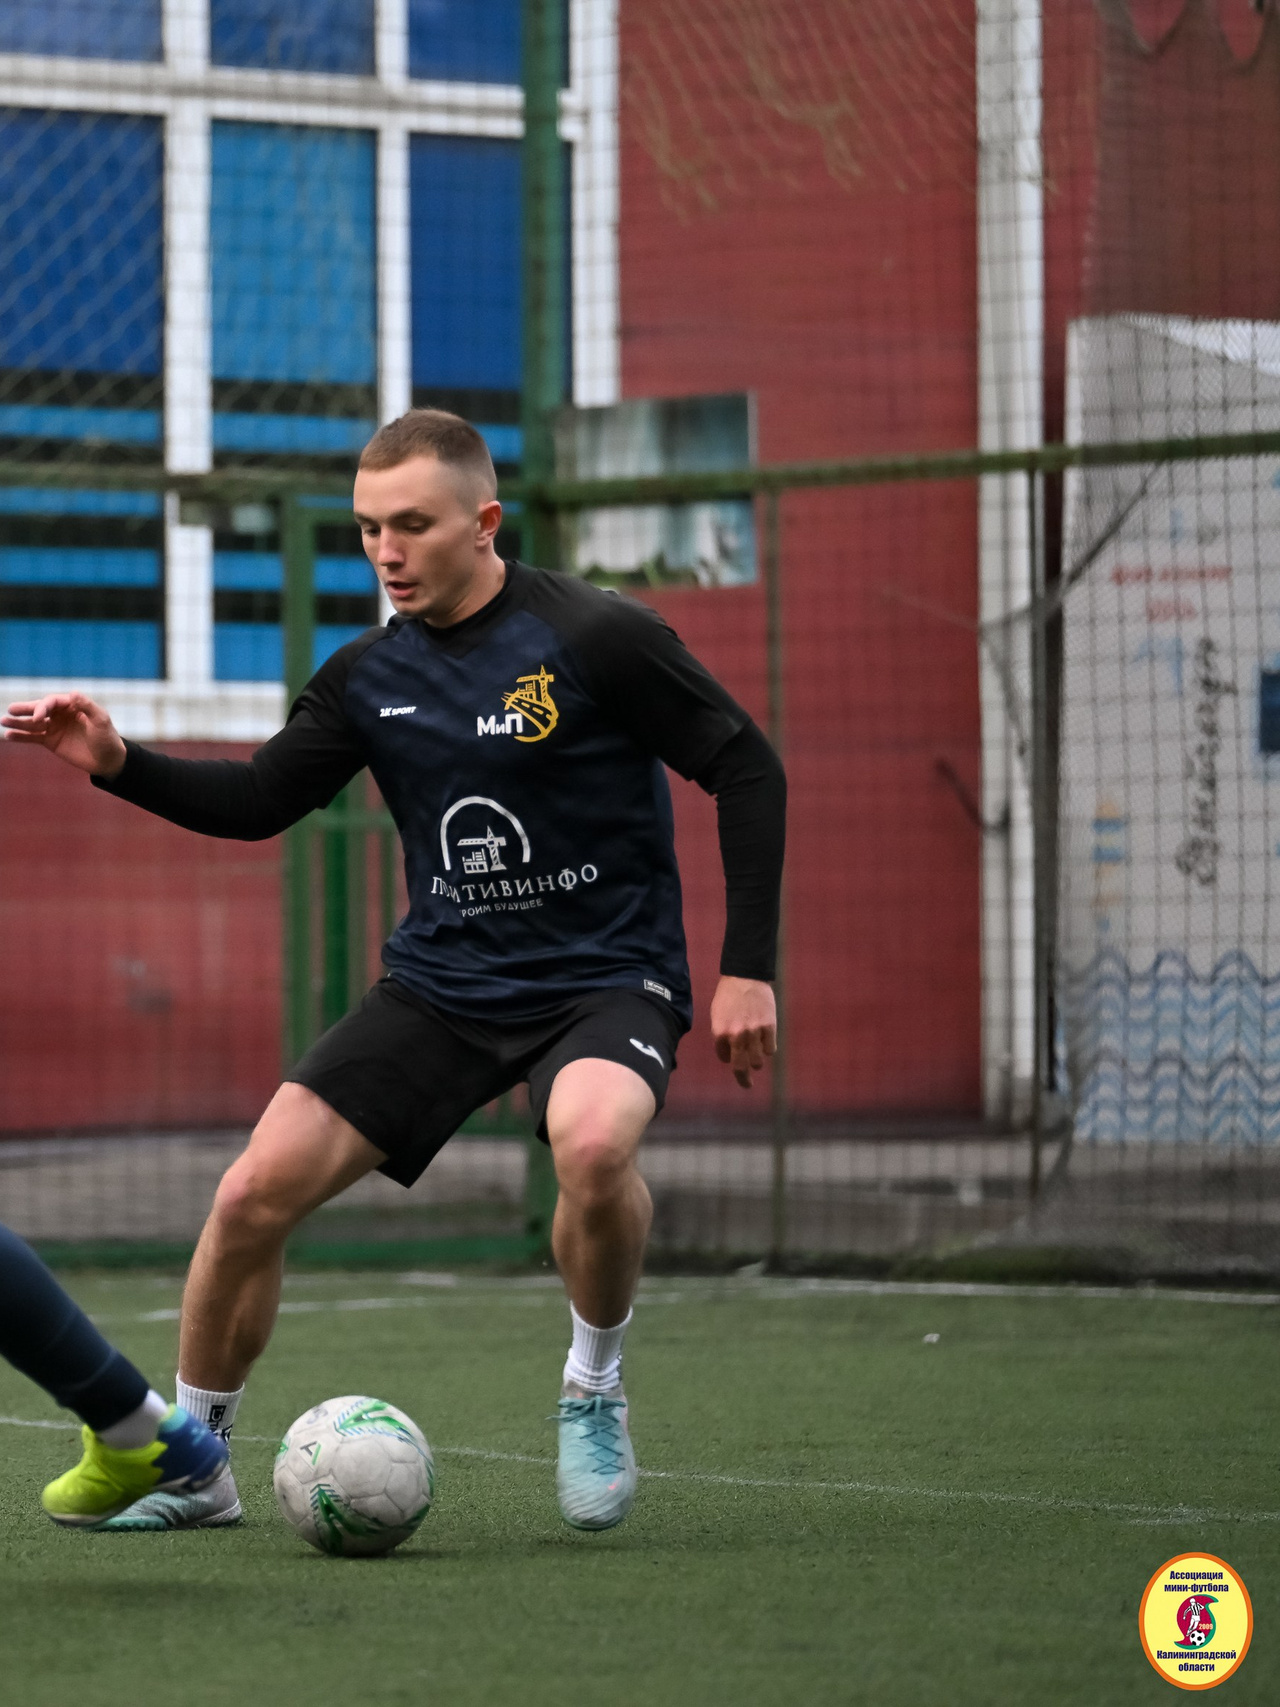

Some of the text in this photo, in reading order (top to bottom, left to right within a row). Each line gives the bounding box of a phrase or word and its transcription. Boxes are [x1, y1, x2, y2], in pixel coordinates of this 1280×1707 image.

[392, 705, 417, 716] SPORT
[476, 713, 524, 737] МиП
[460, 904, 492, 918] РОИМ
